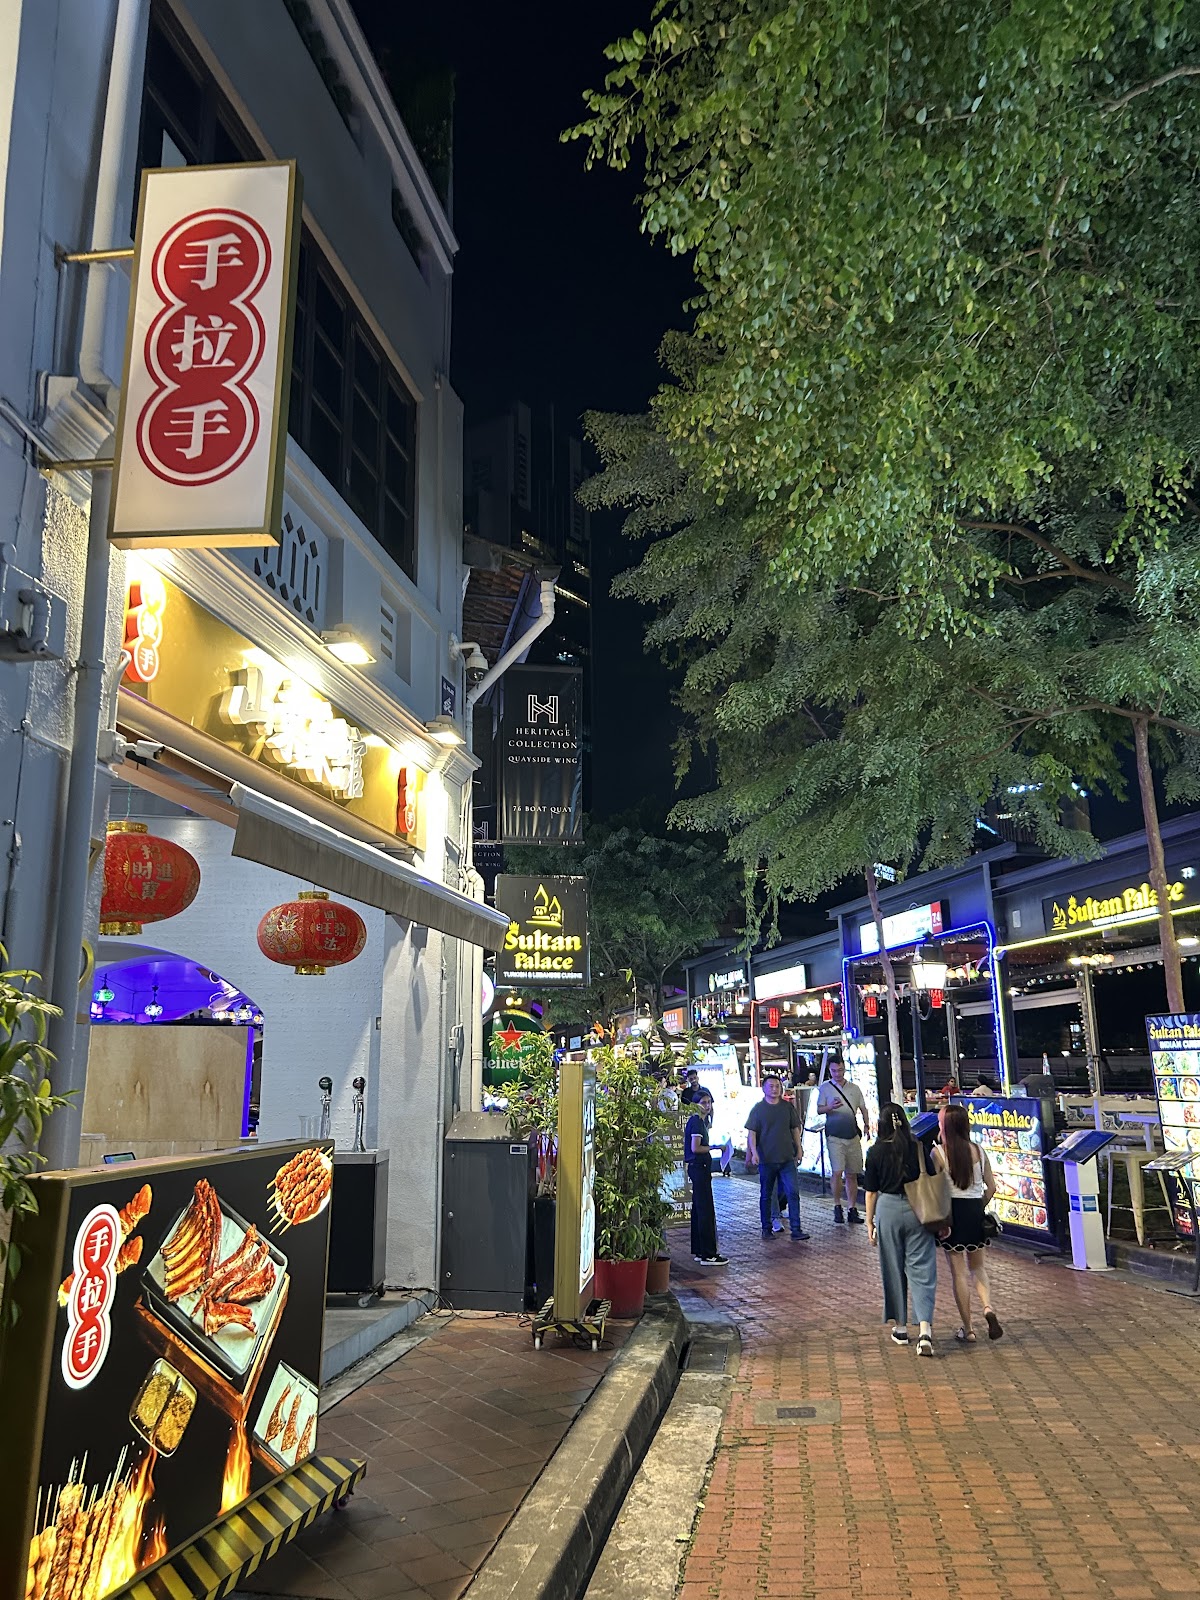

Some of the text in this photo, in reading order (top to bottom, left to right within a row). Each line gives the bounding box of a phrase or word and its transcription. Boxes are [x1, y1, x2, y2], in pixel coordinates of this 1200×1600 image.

[163, 232, 244, 461] 手拉手
[515, 727, 570, 737] HERITAGE
[508, 740, 578, 749] COLLECTION
[508, 755, 551, 764] QUAYSIDE
[550, 806, 573, 815] QUAY
[1067, 896, 1125, 925] Sultan
[1123, 881, 1185, 912] Palae
[931, 911, 942, 924] 74
[504, 928, 582, 952] Sultan
[514, 951, 574, 971] Palace
[1149, 1024, 1183, 1040] Sultan
[967, 1106, 1003, 1127] Sultan
[74, 1225, 110, 1365] 手拉手
